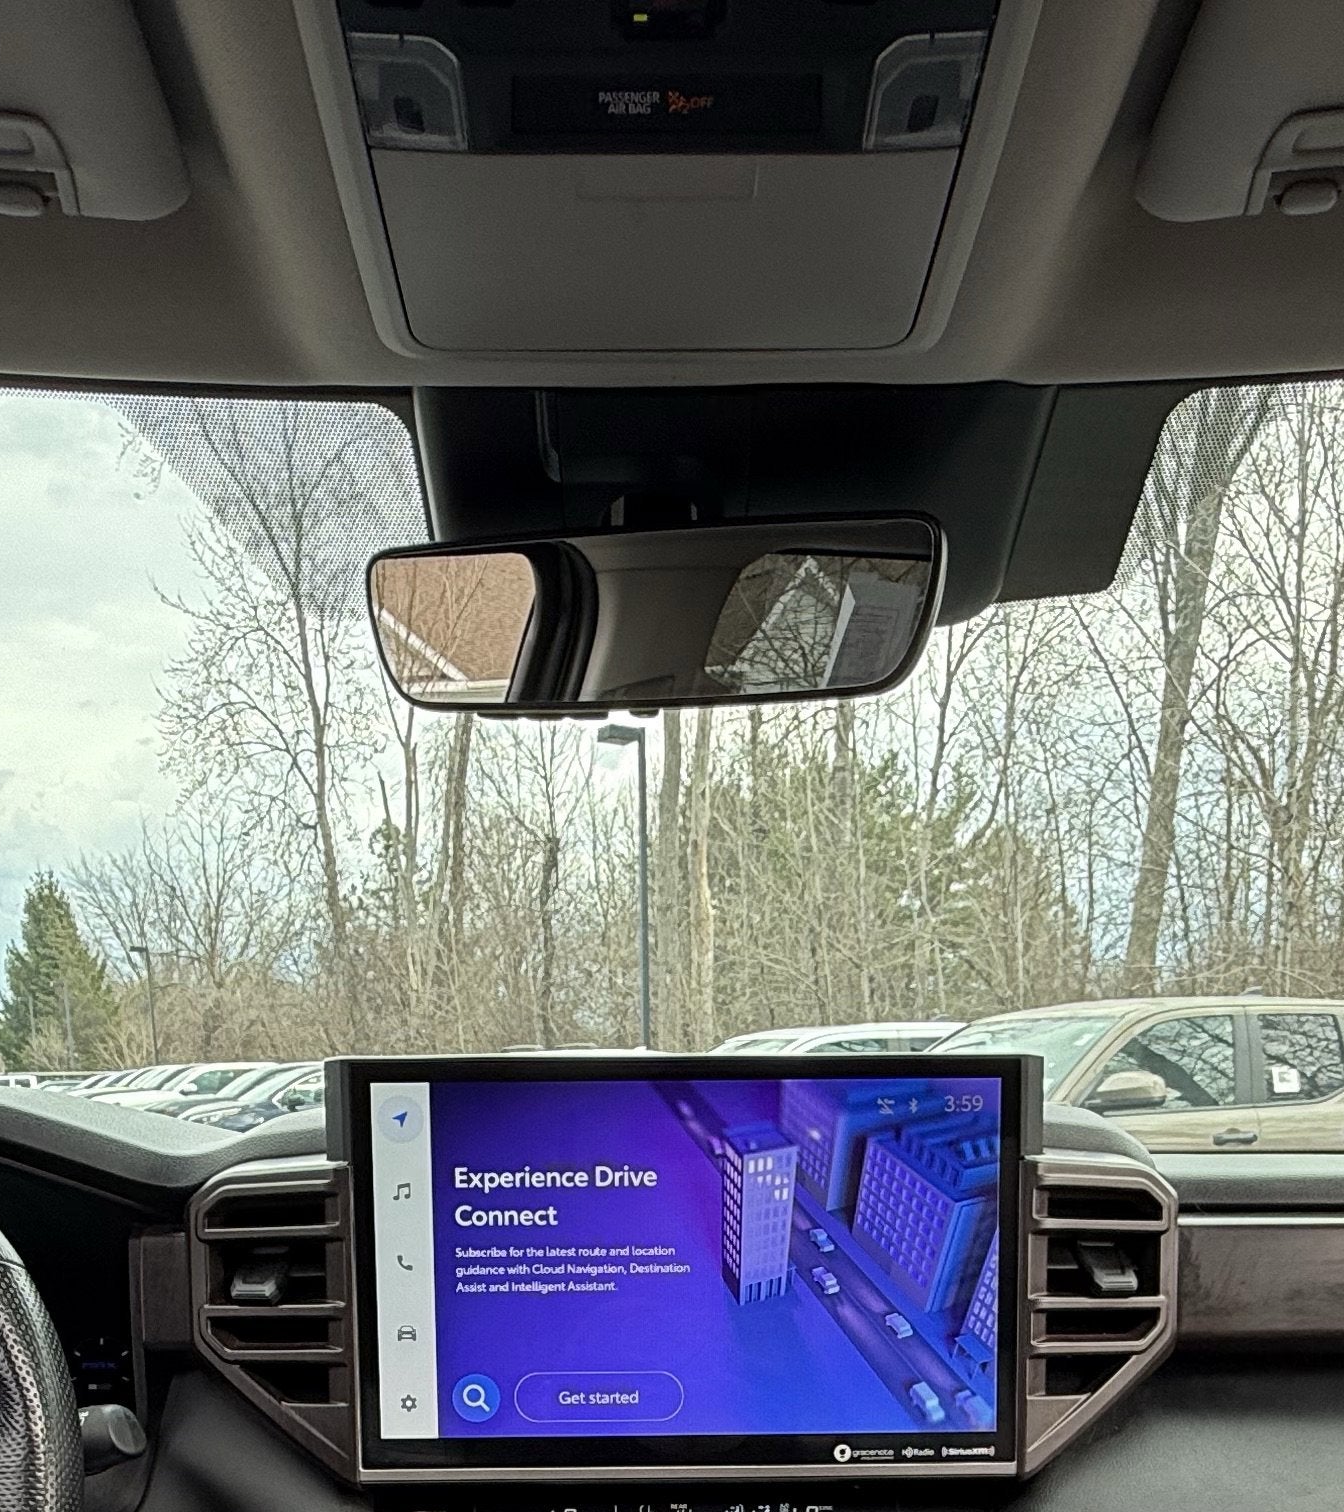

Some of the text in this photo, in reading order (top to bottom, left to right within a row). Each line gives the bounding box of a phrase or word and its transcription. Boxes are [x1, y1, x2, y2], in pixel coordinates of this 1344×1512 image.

[598, 91, 661, 105] PASSENGER
[689, 97, 715, 109] OFF
[607, 103, 652, 115] AIR BAG
[943, 1095, 984, 1112] 3:59
[454, 1165, 658, 1192] Experience Drive
[455, 1204, 558, 1228] Connect
[455, 1245, 676, 1258] Subscribe for the latest route and location
[455, 1263, 691, 1278] guidance with Cloud Navigation, Destination
[456, 1282, 487, 1293] Assist
[489, 1281, 509, 1292] and
[511, 1281, 566, 1294] Intelligent
[558, 1388, 639, 1406] Get started
[914, 1448, 935, 1456] Radio
